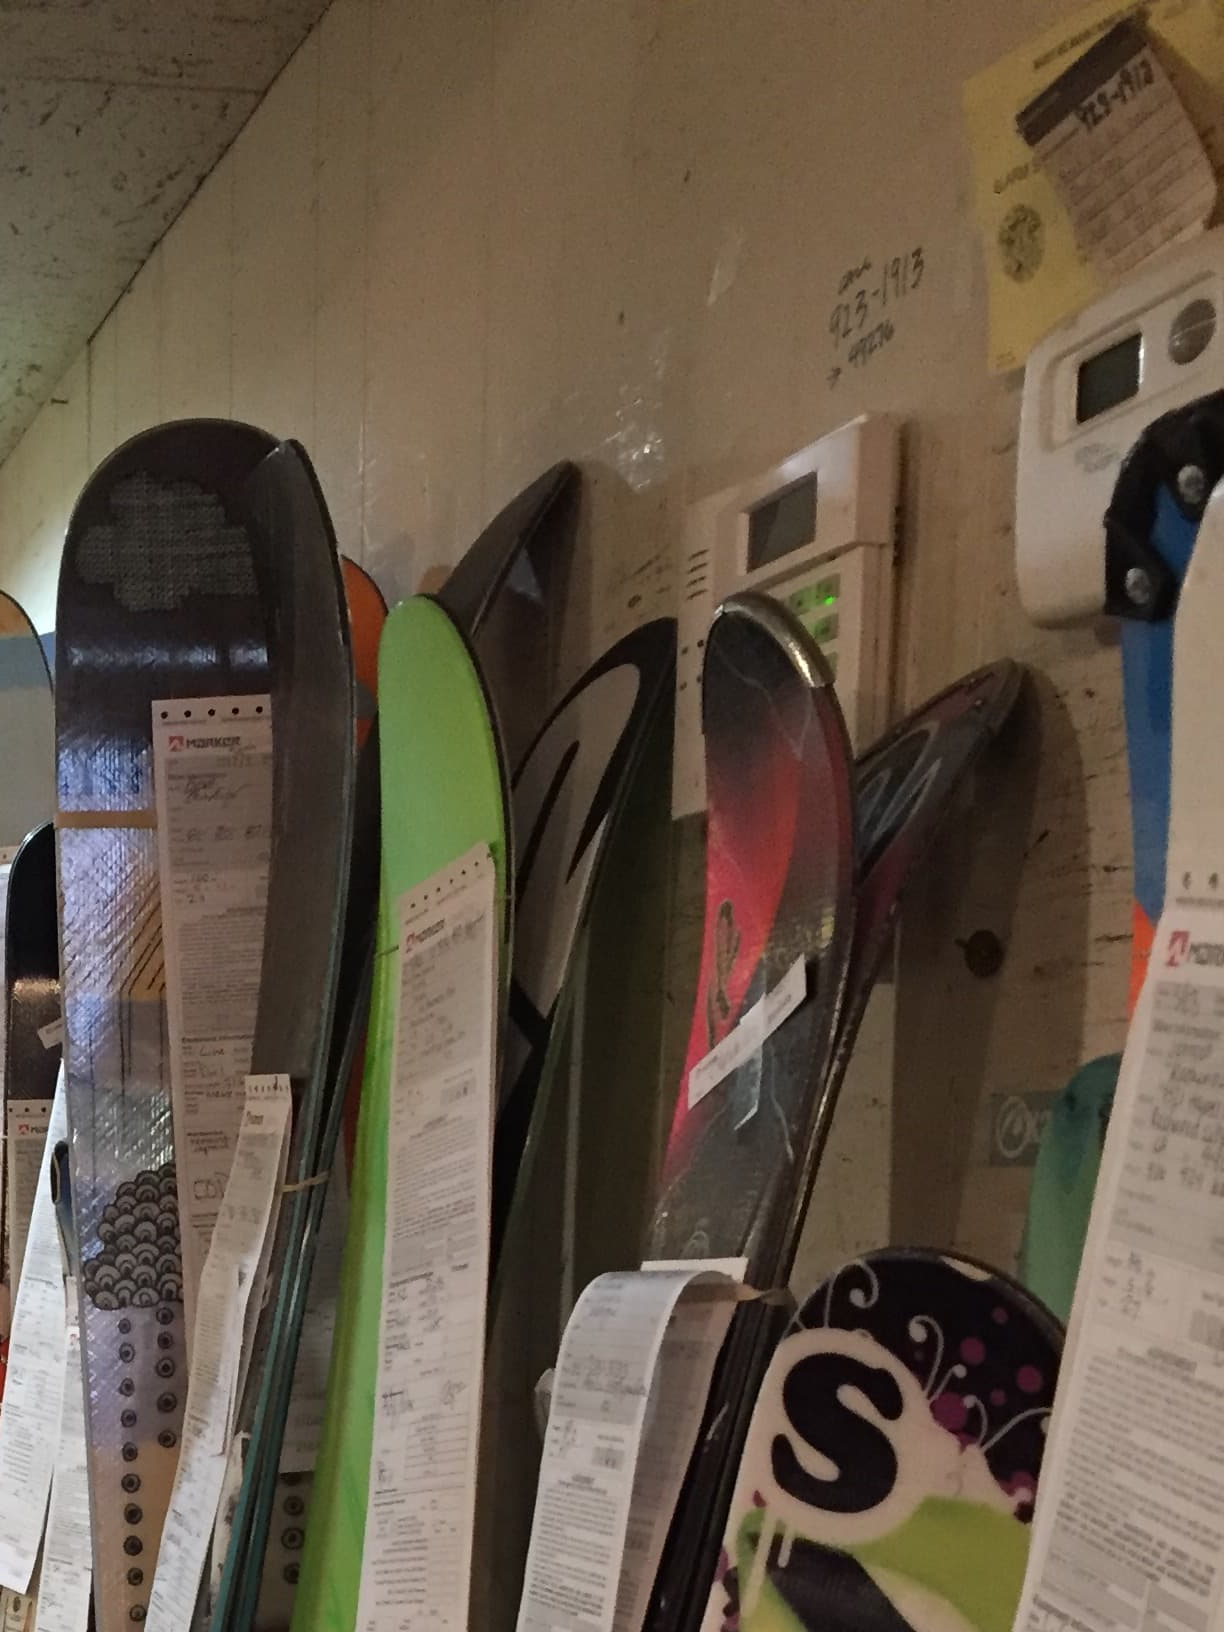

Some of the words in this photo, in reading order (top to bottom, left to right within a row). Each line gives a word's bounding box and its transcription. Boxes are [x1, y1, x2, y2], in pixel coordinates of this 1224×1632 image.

[829, 247, 924, 351] 923-1913
[186, 736, 241, 750] MARKER
[770, 1352, 905, 1514] S
